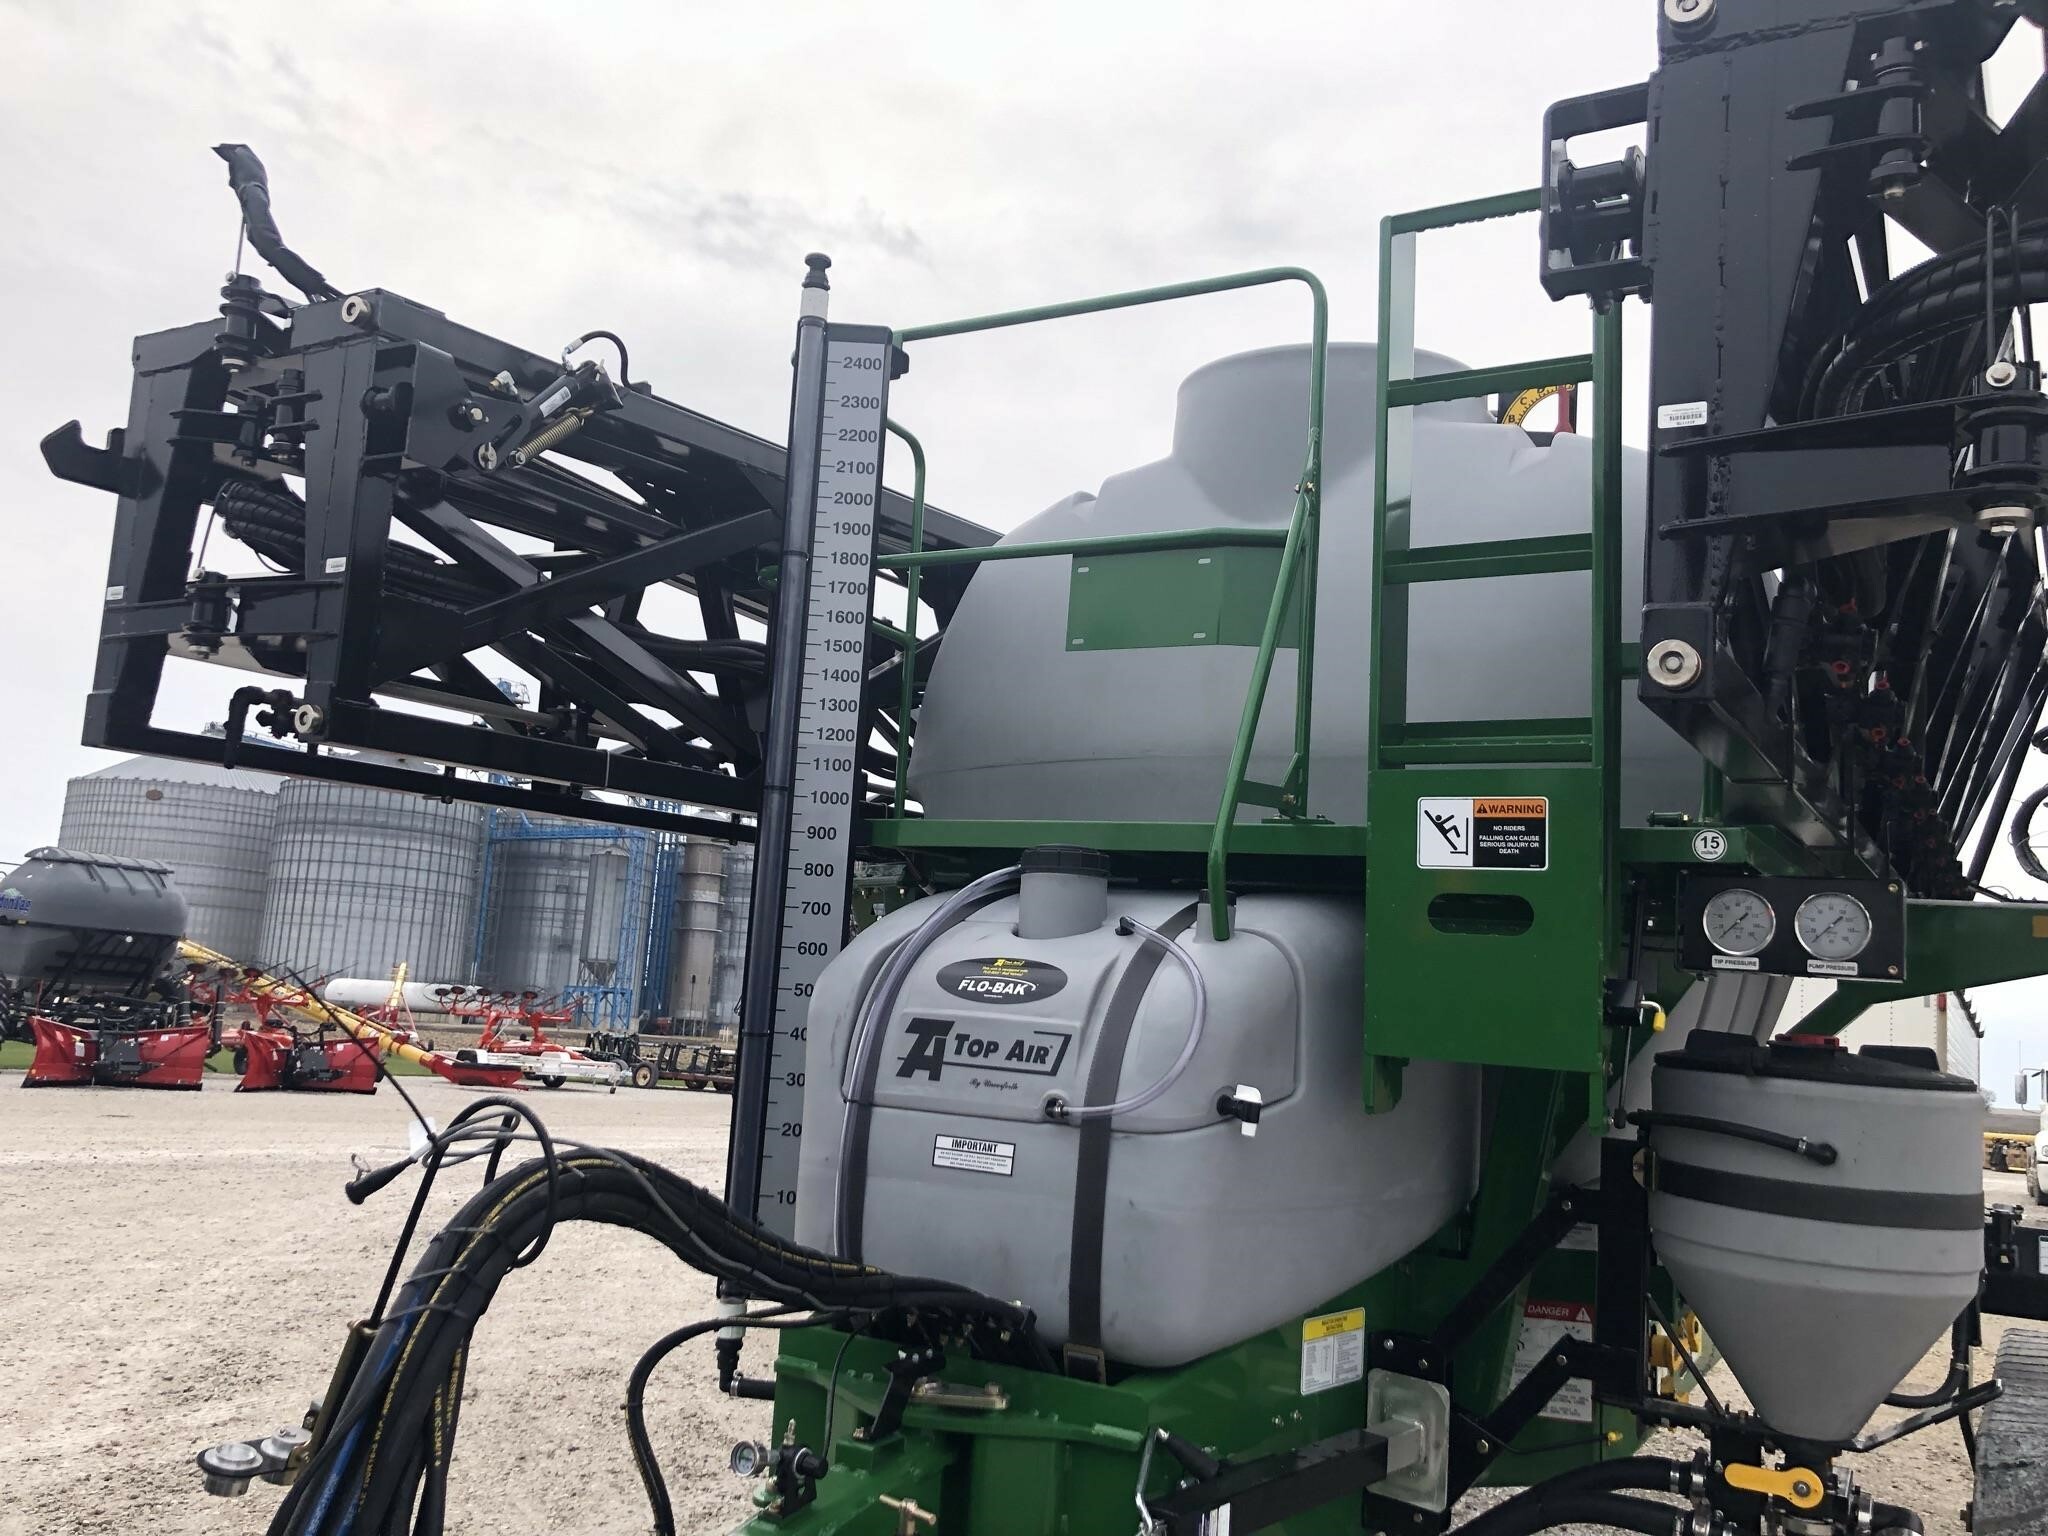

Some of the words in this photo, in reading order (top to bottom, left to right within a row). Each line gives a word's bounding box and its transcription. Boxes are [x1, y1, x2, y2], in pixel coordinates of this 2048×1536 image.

[842, 356, 882, 371] 2400
[840, 395, 880, 410] 2300
[838, 429, 877, 443] 2200
[836, 460, 875, 475] 2100
[834, 492, 873, 506] 2000
[832, 521, 871, 536] 1900
[830, 552, 869, 566] 1800
[828, 581, 867, 595] 1700
[826, 610, 864, 624] 1600
[824, 639, 862, 653] 1500
[821, 668, 860, 683] 1400
[819, 698, 857, 712] 1300
[816, 727, 855, 742] 1200
[813, 758, 852, 772] 1100
[810, 790, 849, 805] 1000
[1489, 804, 1544, 814] WARNING
[807, 826, 837, 840] 900
[1700, 836, 1719, 849] 15
[804, 863, 834, 877] 800
[801, 901, 831, 916] 700
[797, 942, 828, 956] 600
[1826, 964, 1856, 972] PRESSURE
[958, 980, 1028, 995] FLO-BAK
[952, 1139, 998, 1153] IMPORTANT
[1527, 1305, 1569, 1317] DANGER
